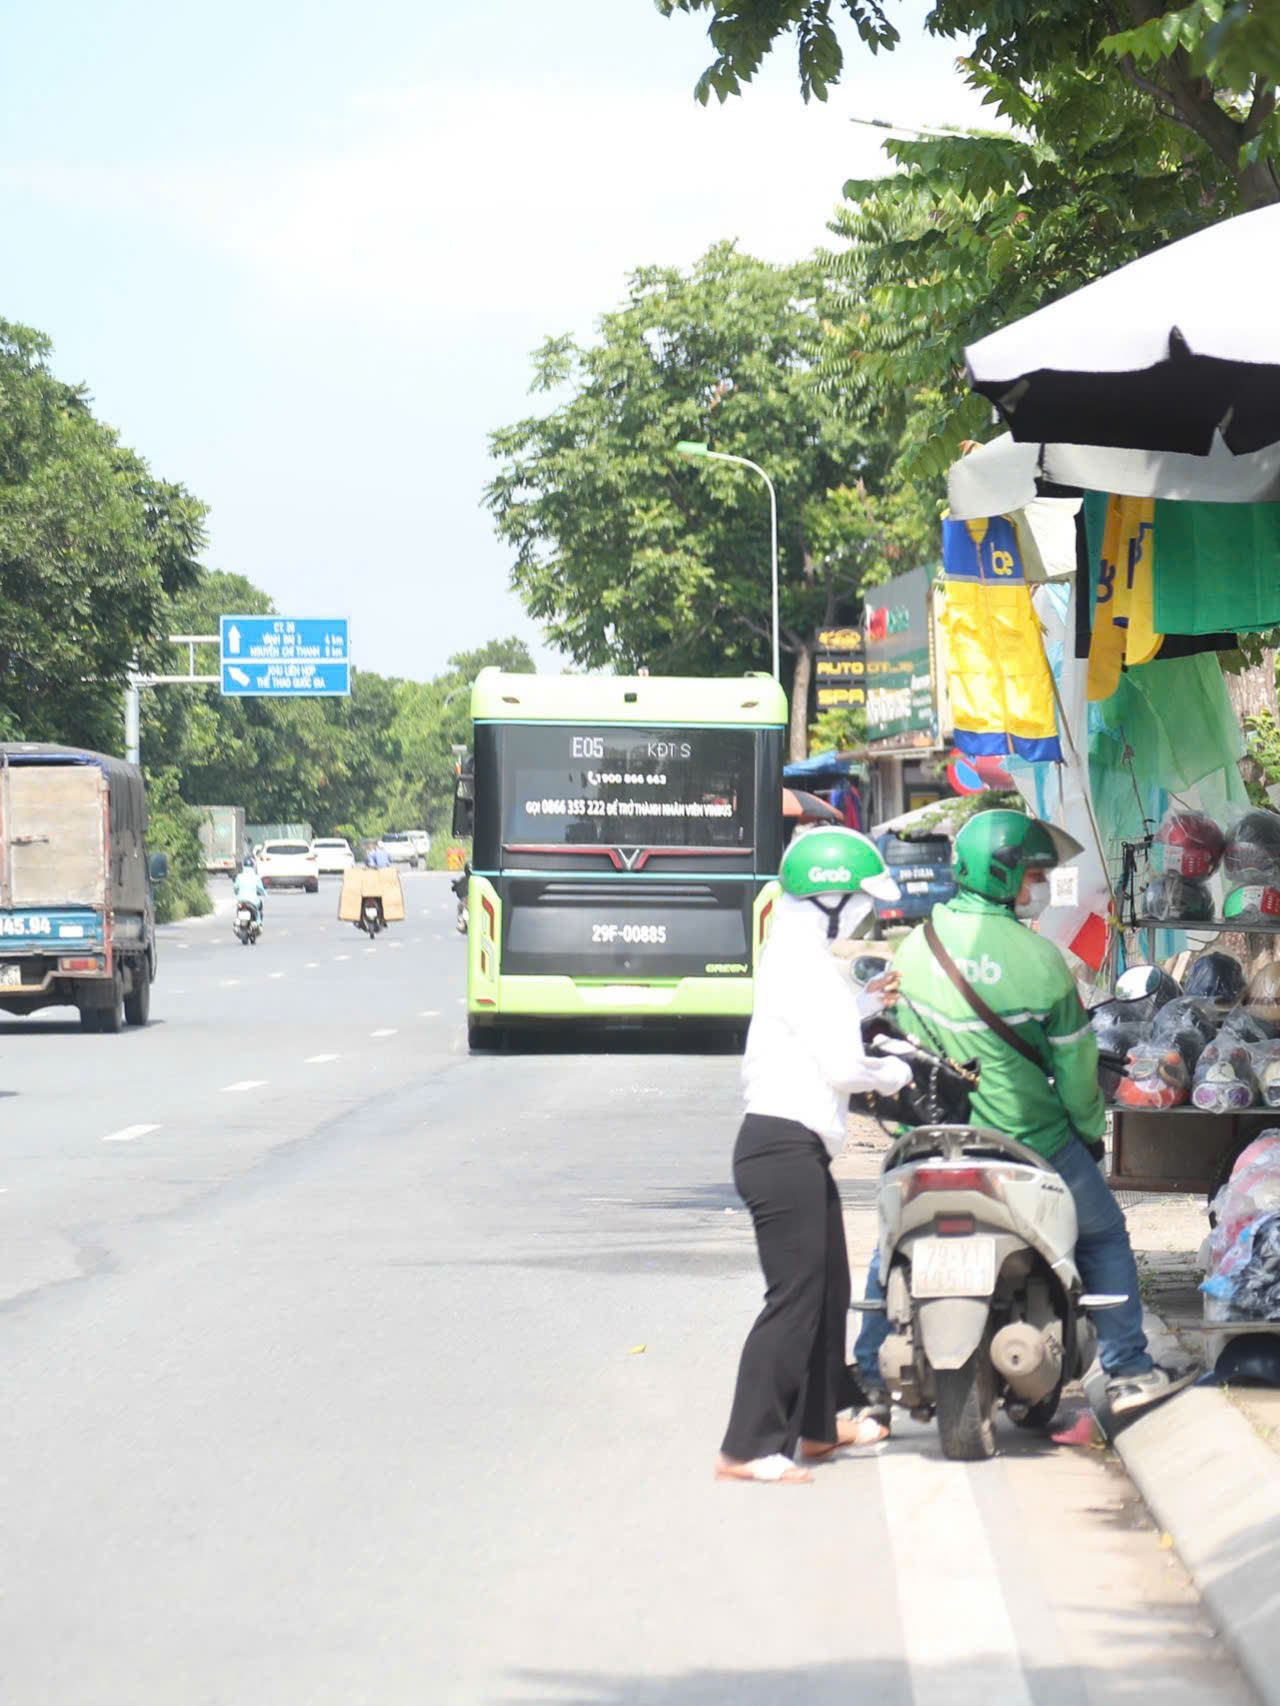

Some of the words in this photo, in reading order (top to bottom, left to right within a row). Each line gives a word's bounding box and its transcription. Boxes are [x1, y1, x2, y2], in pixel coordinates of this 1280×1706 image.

[817, 661, 865, 675] AUTO
[817, 687, 865, 705] SPA
[572, 736, 604, 758] E05
[587, 799, 606, 816] 222
[808, 866, 852, 883] Grab
[591, 924, 667, 943] 29F-00885
